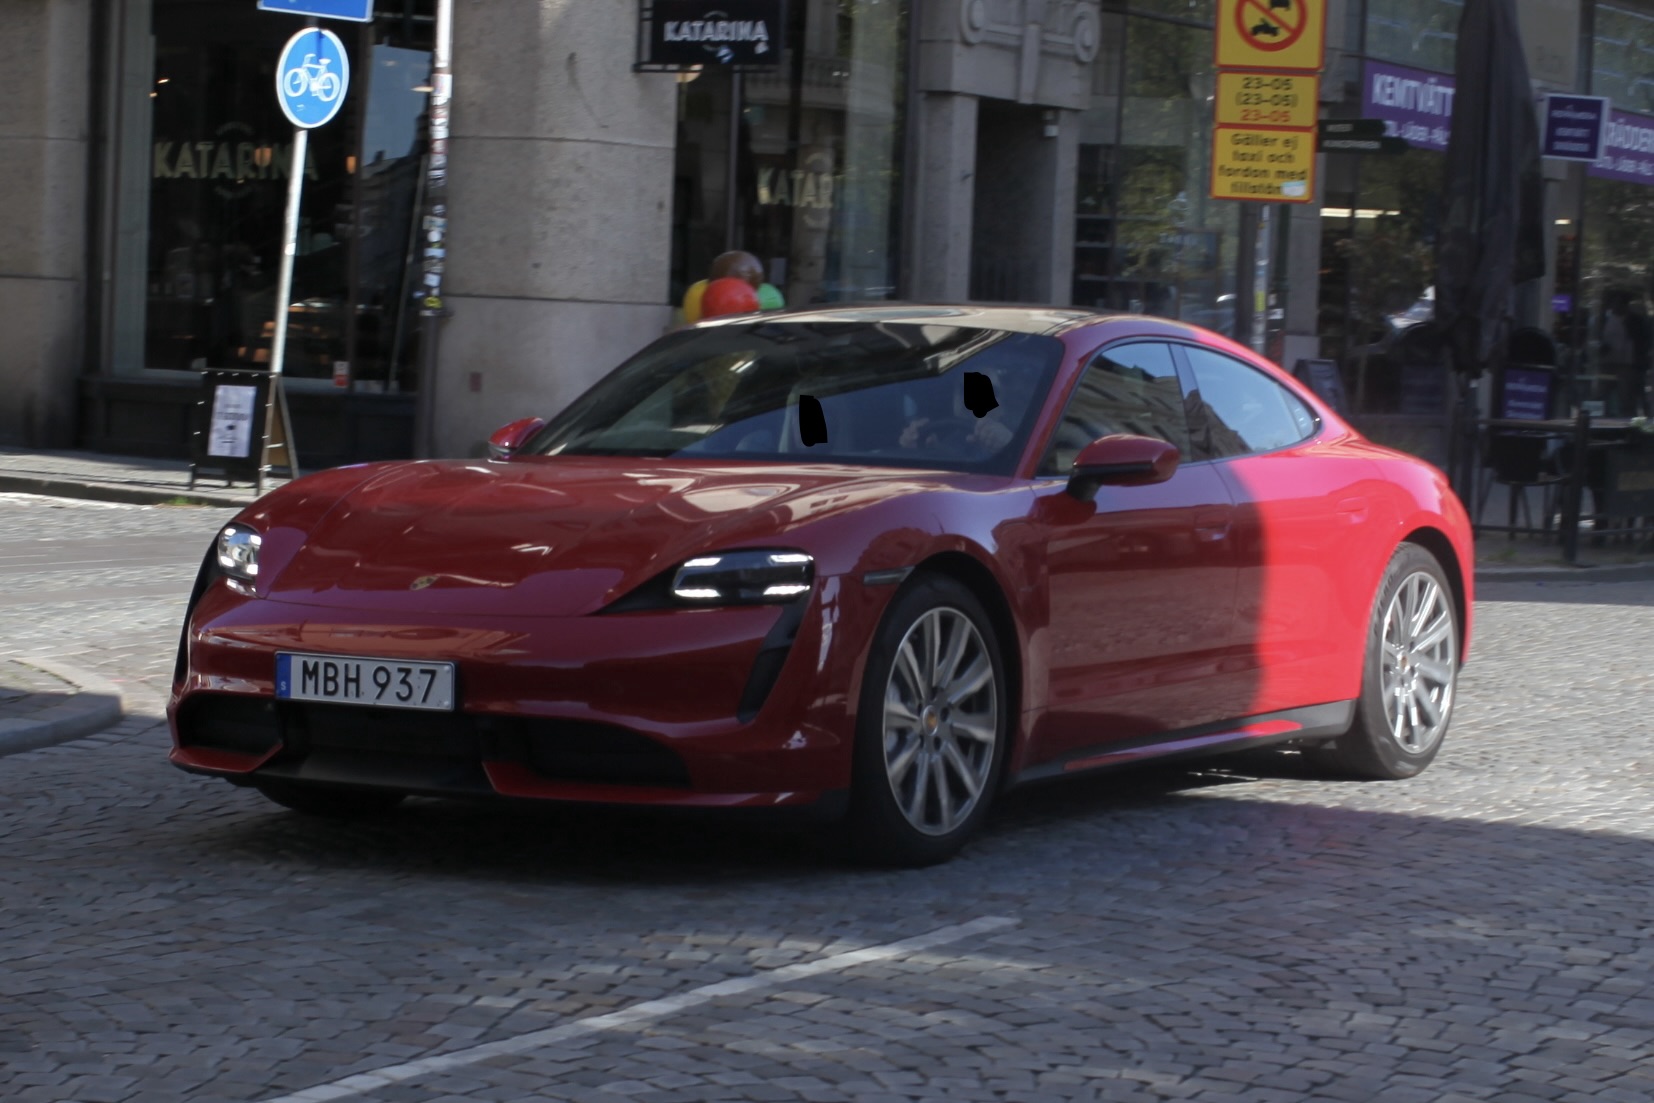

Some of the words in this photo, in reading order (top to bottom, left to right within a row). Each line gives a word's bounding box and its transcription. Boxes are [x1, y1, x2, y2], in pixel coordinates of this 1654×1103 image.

[663, 20, 768, 41] KATARINA
[1231, 133, 1277, 147] Gäller
[1282, 136, 1298, 151] ej
[1232, 150, 1262, 162] taxi
[1266, 153, 1295, 164] och
[1218, 164, 1270, 178] fordon
[1274, 168, 1307, 181] med
[280, 680, 287, 692] S
[301, 659, 361, 699] MBH
[372, 665, 437, 704] 937
